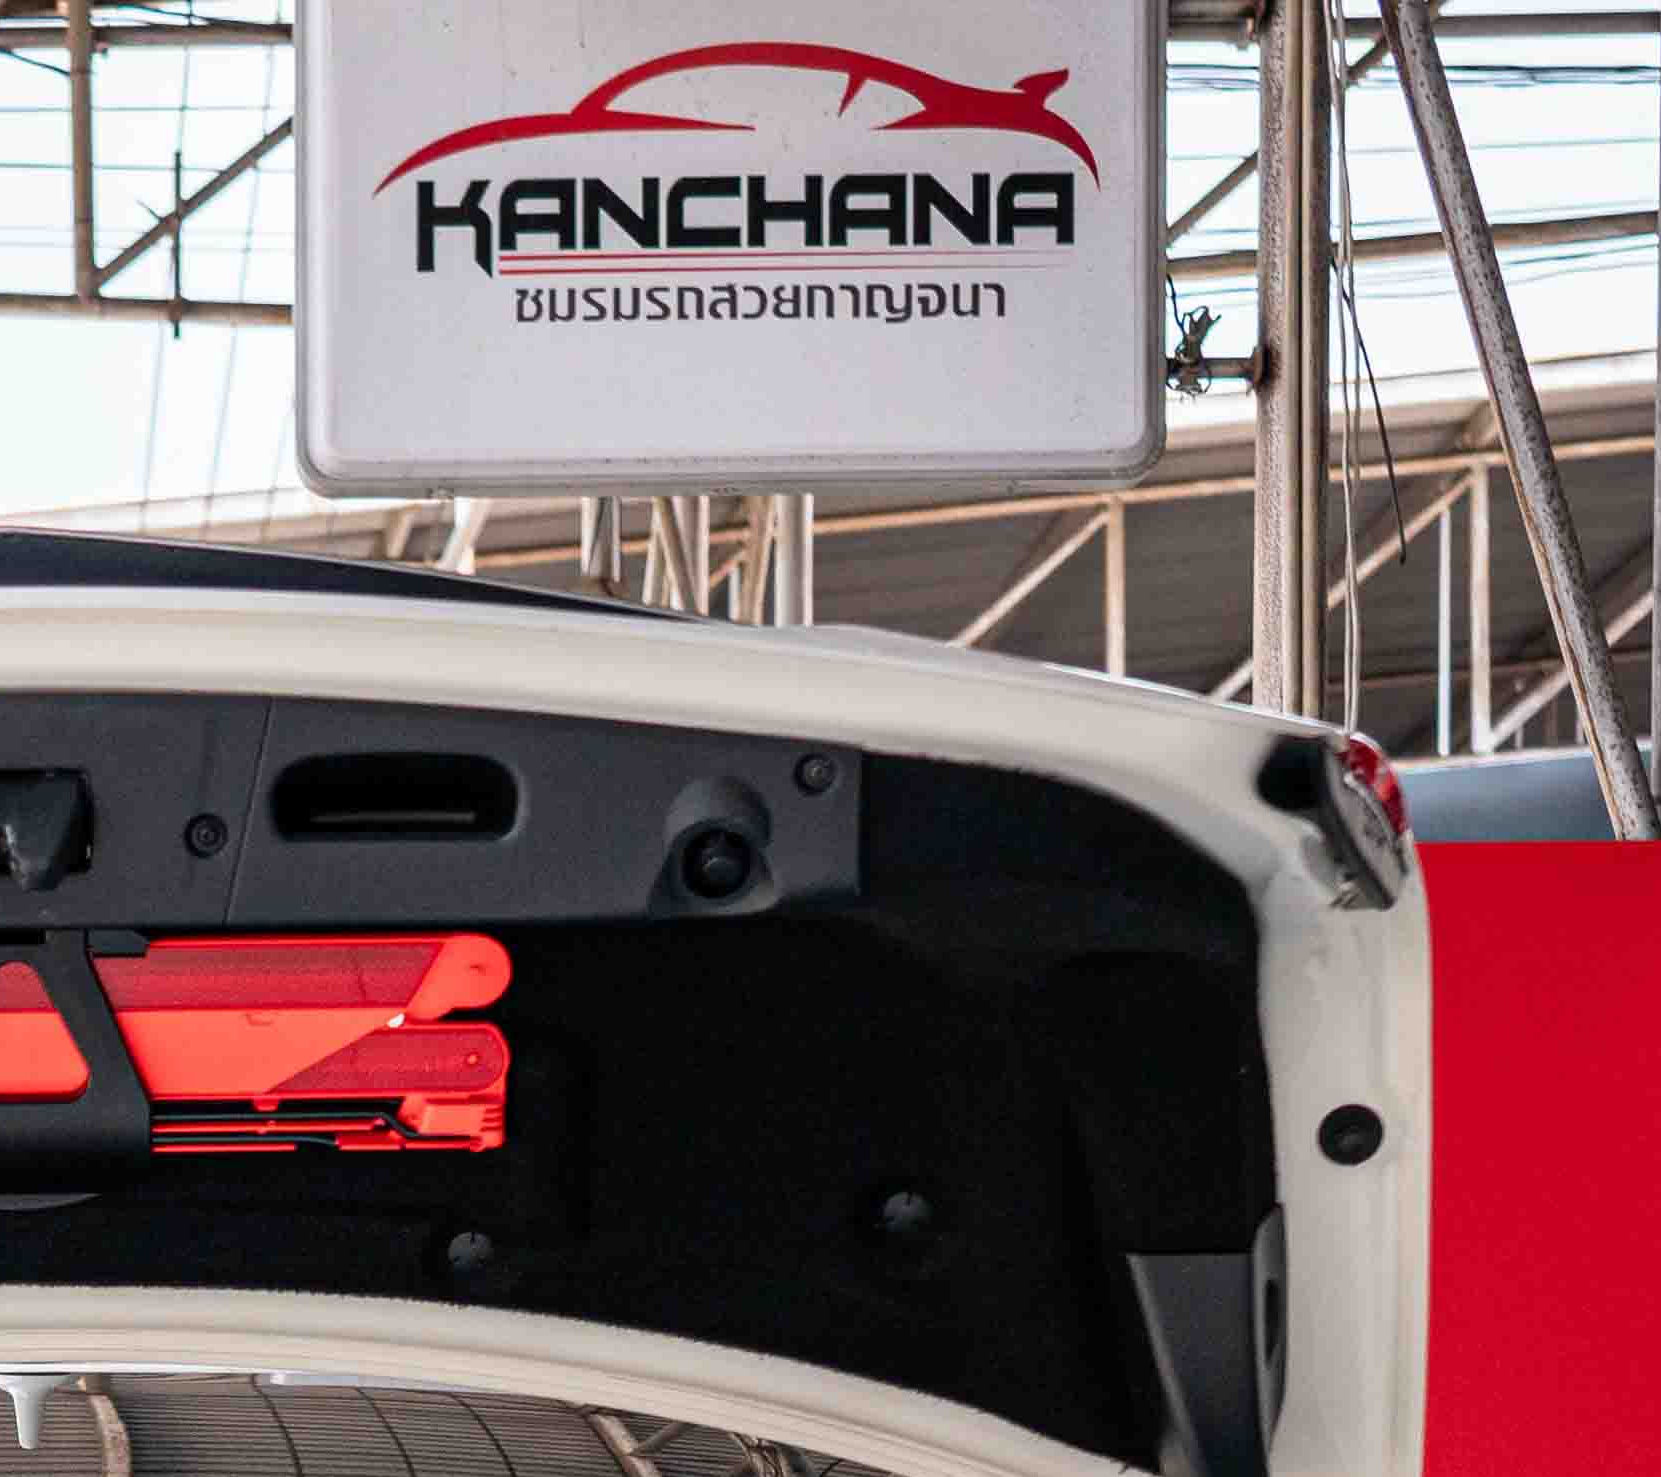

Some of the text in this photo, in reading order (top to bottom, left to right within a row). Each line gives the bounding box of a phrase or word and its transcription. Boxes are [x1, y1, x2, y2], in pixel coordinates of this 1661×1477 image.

[417, 172, 1076, 277] KANCHANA
[514, 283, 1007, 324] ชมรมรถสวยกาญจนา
